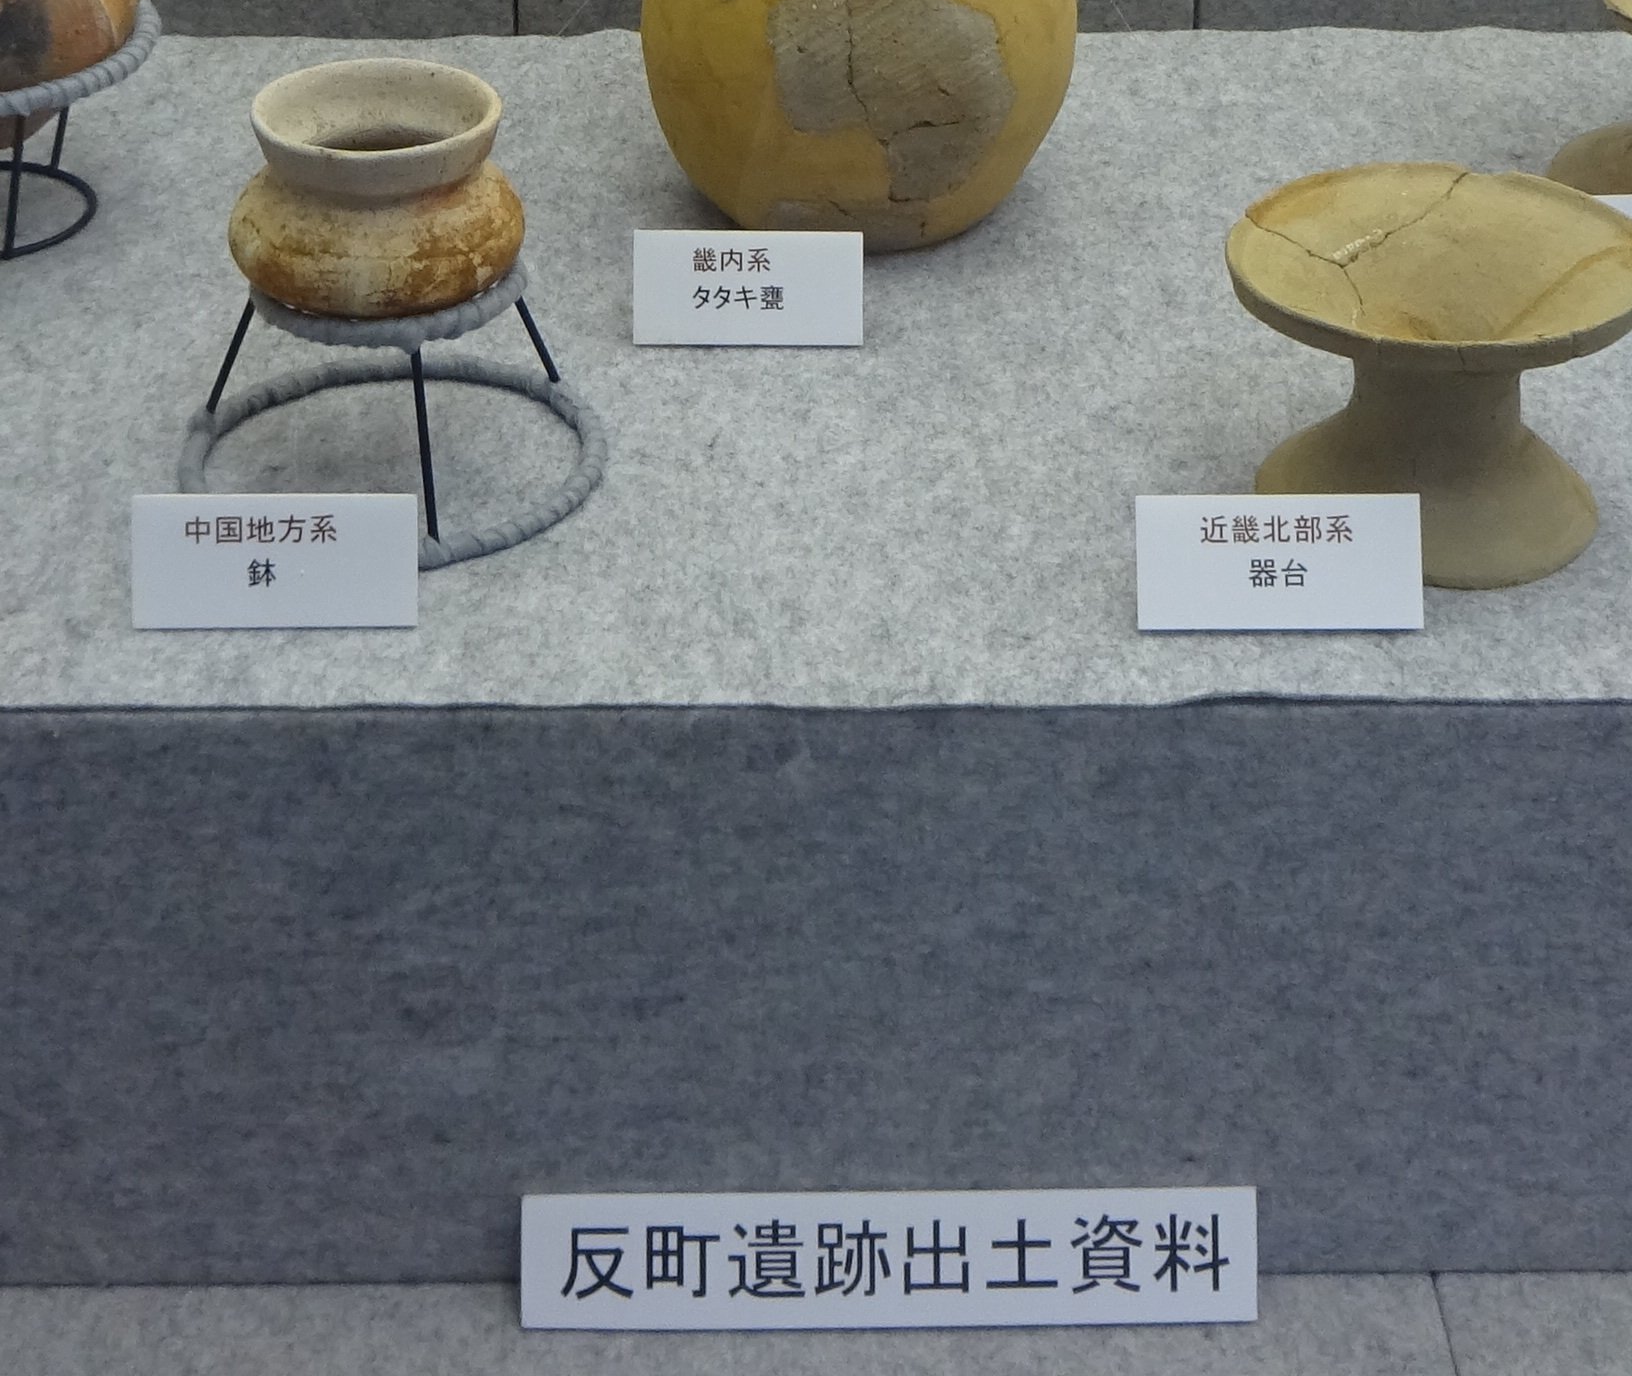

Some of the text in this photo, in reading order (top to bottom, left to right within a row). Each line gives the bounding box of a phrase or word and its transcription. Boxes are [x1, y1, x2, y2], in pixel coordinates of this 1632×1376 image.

[692, 247, 771, 272] 畿内系
[692, 285, 784, 311] タタキ甕
[185, 514, 337, 544] 中国地方系
[1200, 514, 1353, 544] 近畿北部系
[247, 558, 277, 587] 鉢
[1248, 558, 1308, 588] 器台
[561, 1213, 1231, 1301] 反町遺跡出土資料
